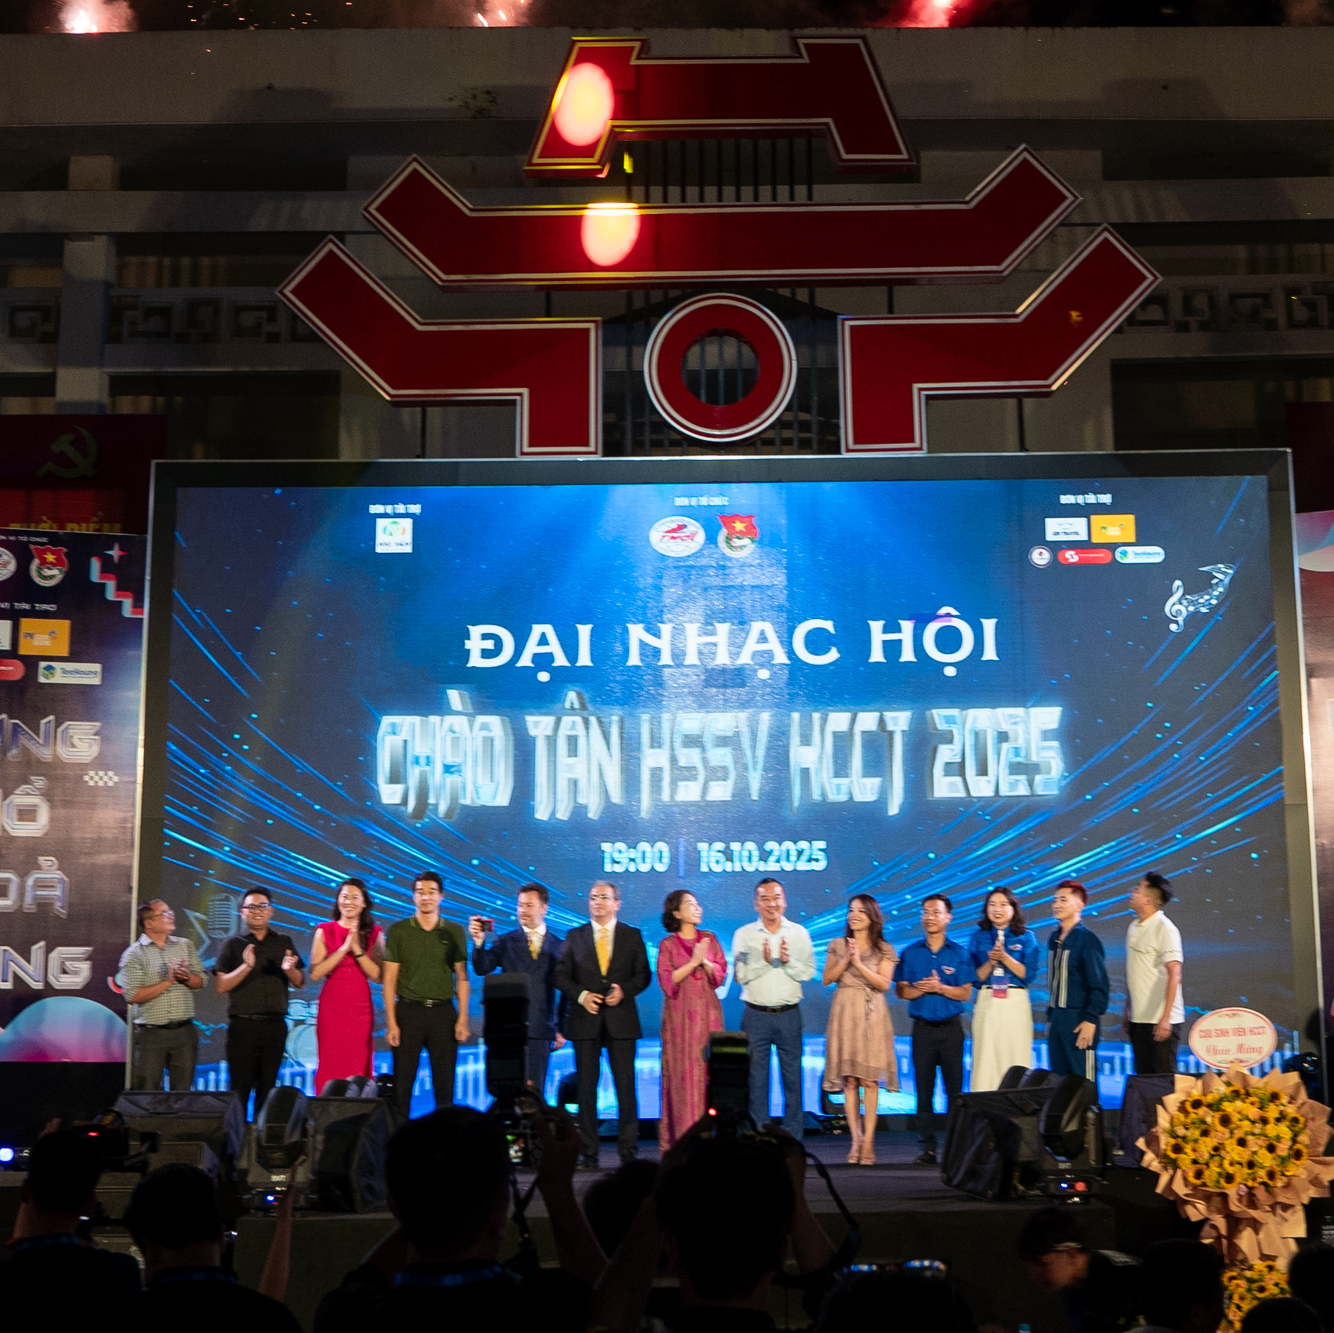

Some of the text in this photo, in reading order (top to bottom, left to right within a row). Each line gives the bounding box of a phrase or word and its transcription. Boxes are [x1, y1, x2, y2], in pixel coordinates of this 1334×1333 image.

[464, 605, 1000, 682] ĐẠI NHẠC HỘI
[376, 689, 1065, 820] CHÀO TÂN HSSV HCCT 2025
[600, 840, 829, 873] 19:00 16.10.2025
